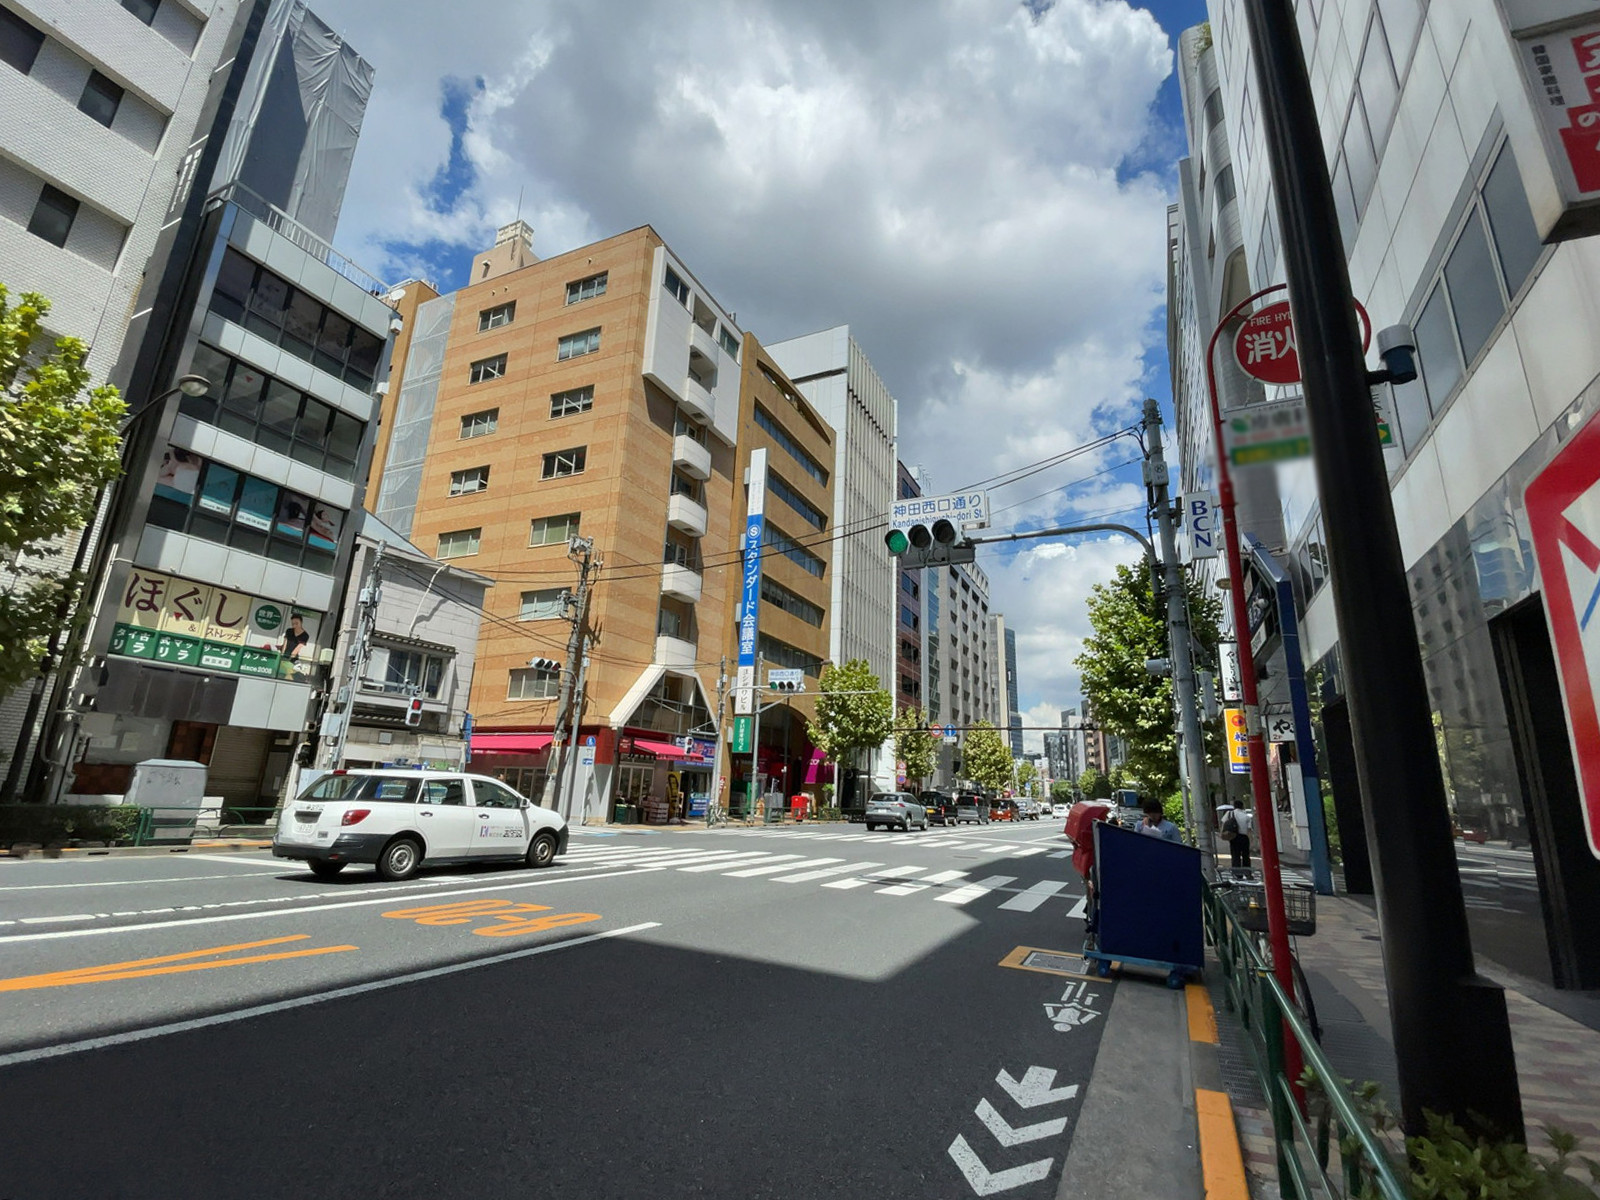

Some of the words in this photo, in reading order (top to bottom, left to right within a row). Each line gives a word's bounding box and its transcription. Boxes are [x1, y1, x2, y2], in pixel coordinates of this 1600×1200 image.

[1250, 315, 1272, 327] FIRE
[1244, 326, 1298, 364] 消火
[893, 494, 981, 517] 神田西口通り
[973, 508, 984, 519] St.
[1191, 500, 1212, 549] BCN
[125, 572, 243, 628] ほぐし
[740, 540, 758, 655] スタンダード会議室
[206, 626, 242, 641] ストレッチ
[113, 638, 190, 661] リラリラ
